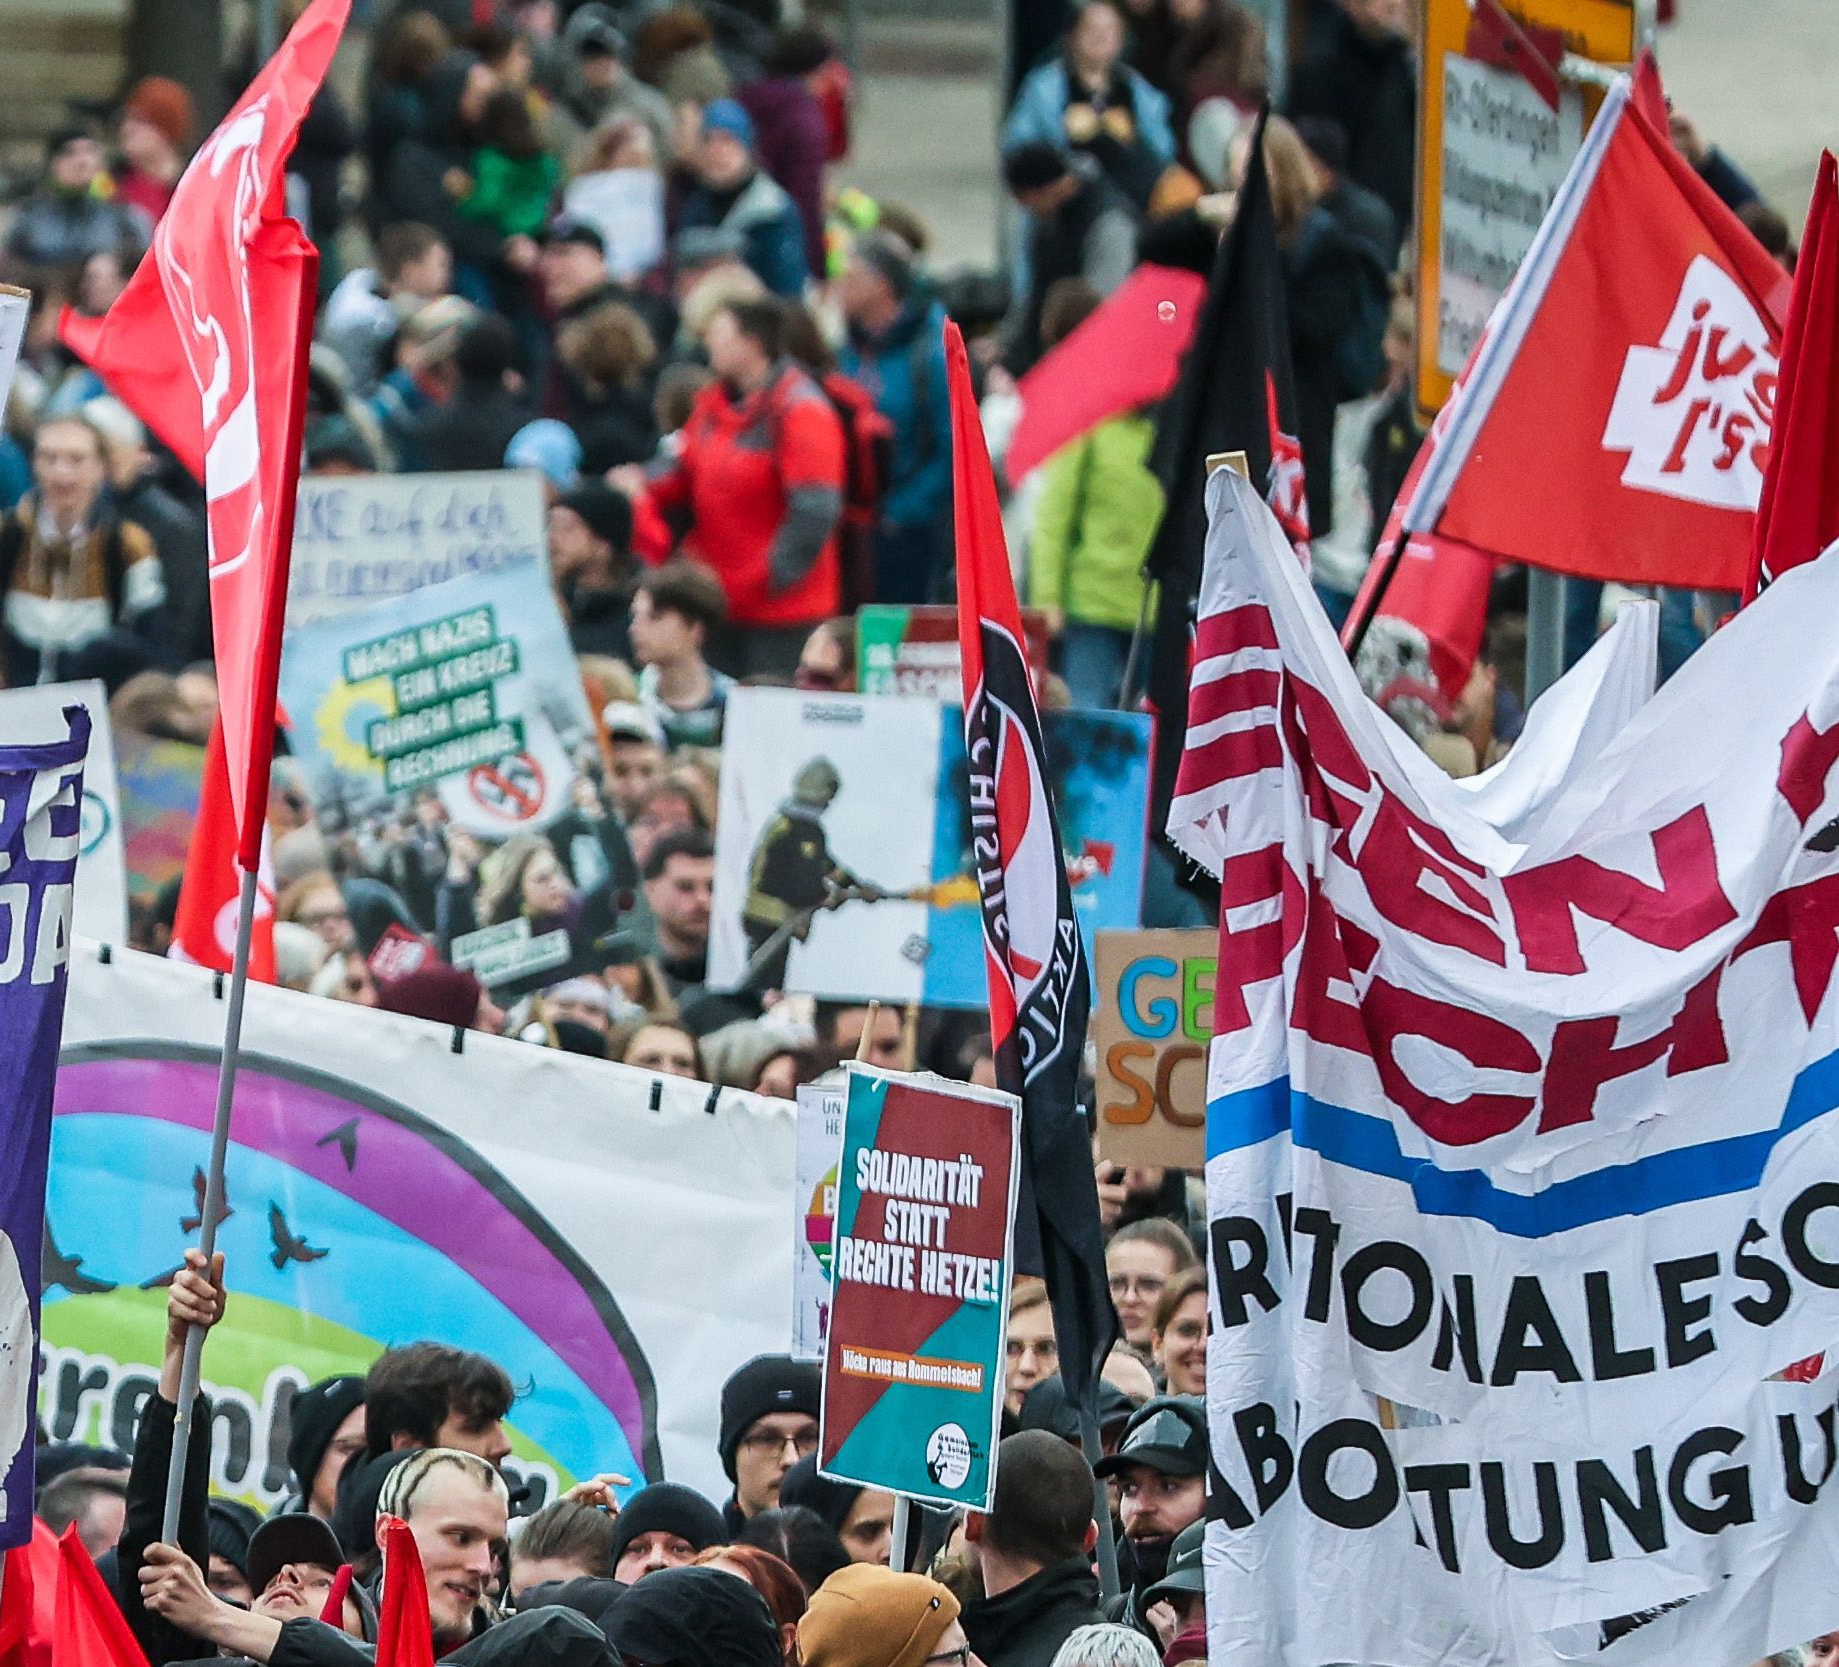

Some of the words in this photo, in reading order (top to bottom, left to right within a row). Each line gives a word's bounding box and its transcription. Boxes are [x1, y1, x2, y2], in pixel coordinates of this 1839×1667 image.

[856, 1146, 984, 1209] SOLIDARITÄT
[883, 1198, 951, 1250] STATT
[838, 1235, 916, 1292] RECHTE
[920, 1249, 1001, 1304] HETZE!
[869, 1355, 892, 1377] raus
